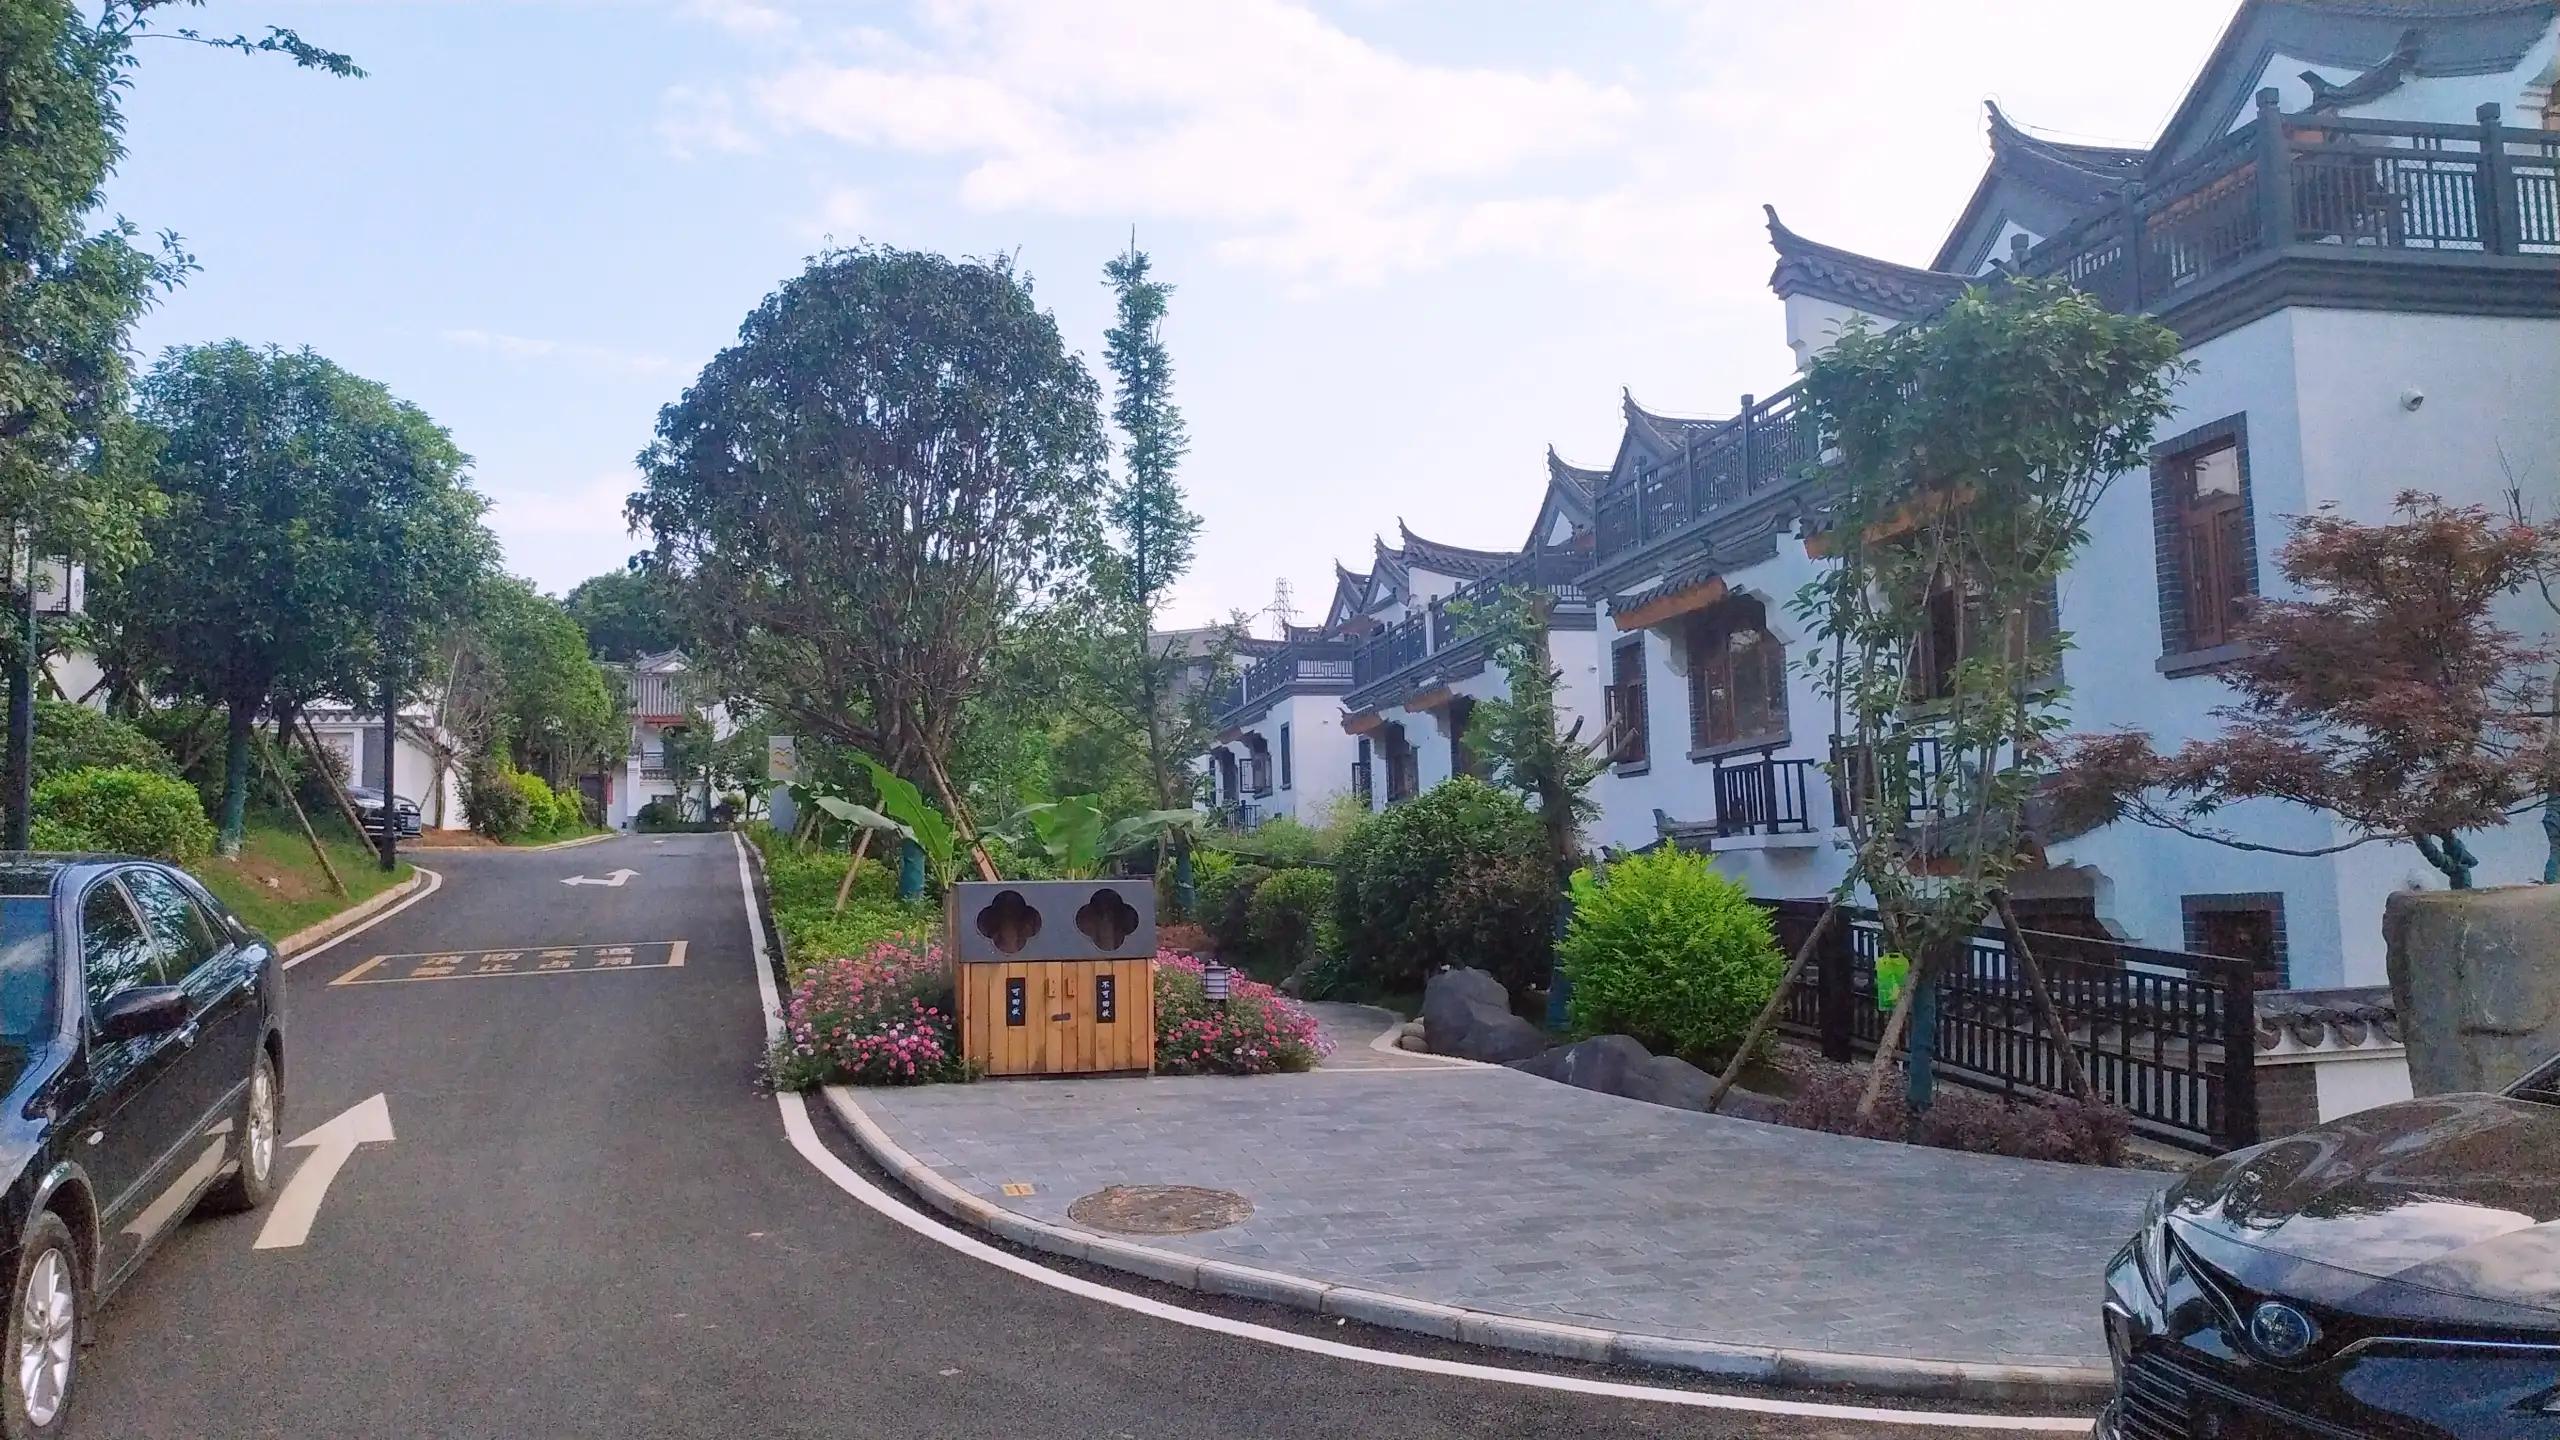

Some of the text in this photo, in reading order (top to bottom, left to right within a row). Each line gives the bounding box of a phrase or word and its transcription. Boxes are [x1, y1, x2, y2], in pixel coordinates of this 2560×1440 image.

[1011, 987, 1021, 1016] 可回收
[1101, 980, 1111, 1018] 不可回收
